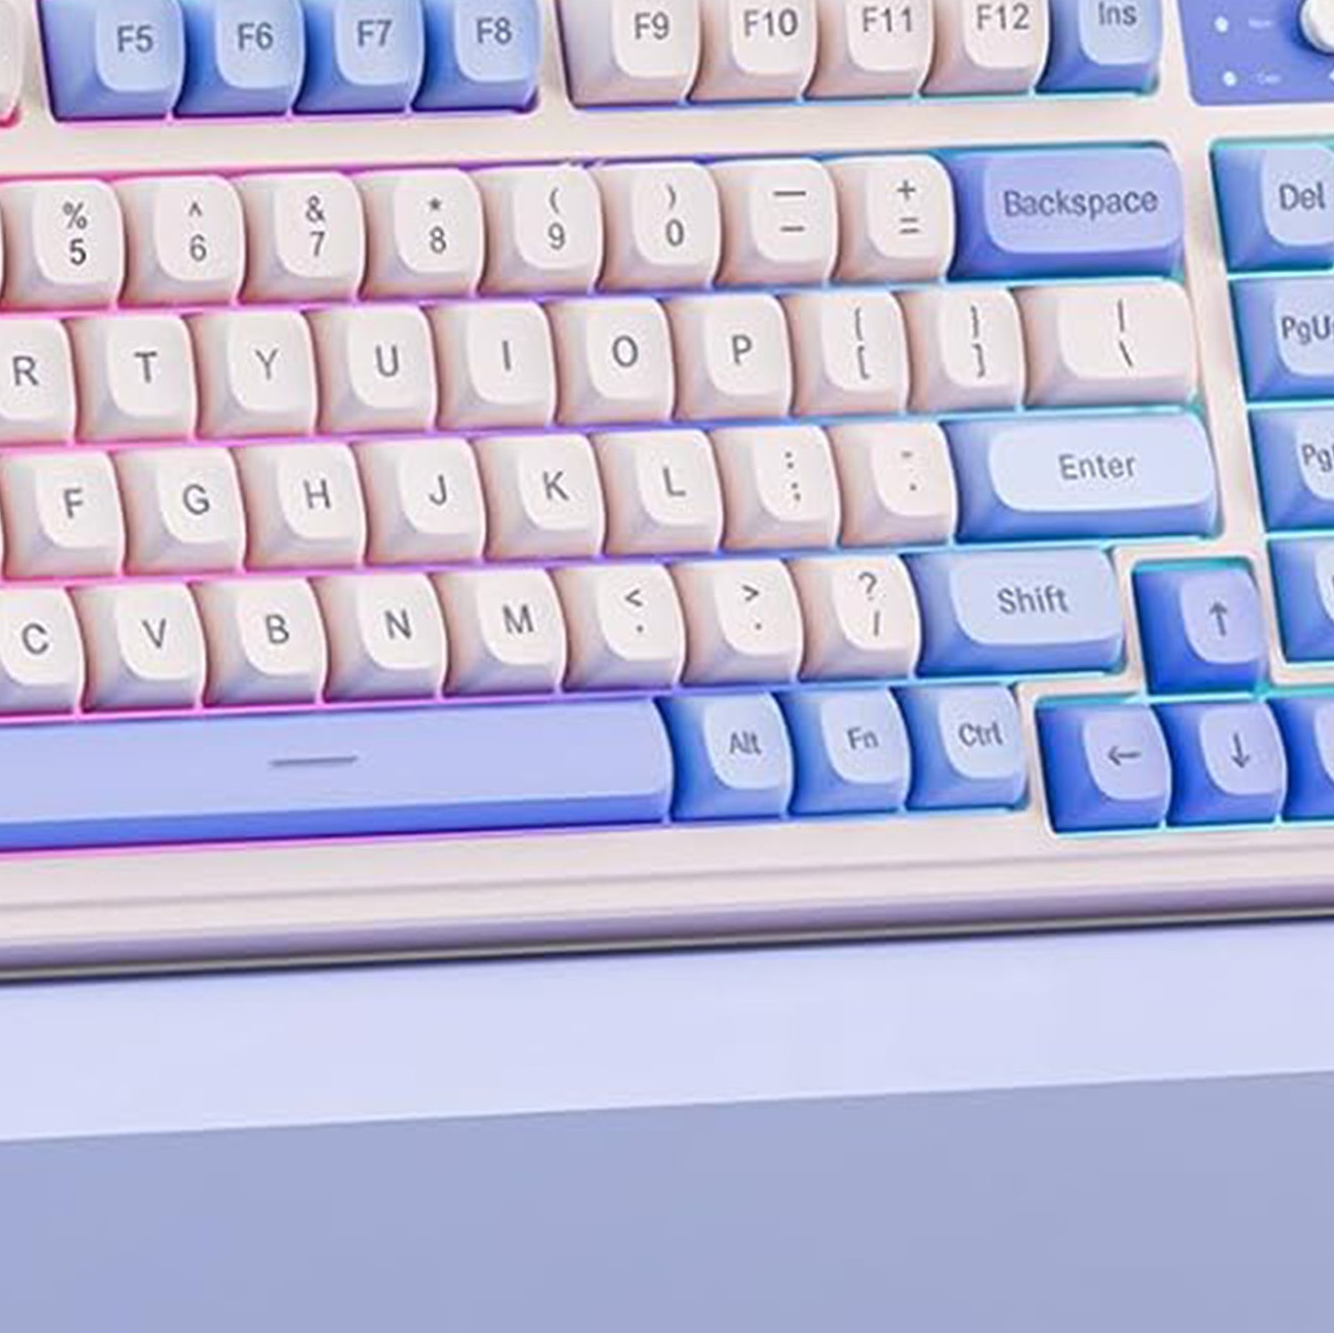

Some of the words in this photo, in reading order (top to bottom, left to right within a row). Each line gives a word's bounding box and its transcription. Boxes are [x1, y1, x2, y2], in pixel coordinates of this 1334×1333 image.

[635, 12, 669, 40] F9
[744, 9, 798, 36] F10
[862, 7, 911, 32] F11
[977, 3, 1029, 30] F12
[1099, 1, 1136, 25] Ins
[117, 25, 153, 52] F5
[238, 22, 273, 50] F6
[357, 20, 391, 47] F7
[477, 17, 512, 45] F8
[897, 180, 916, 200] +
[1279, 182, 1325, 210] Del
[63, 202, 87, 229] %
[306, 196, 324, 222] &
[1004, 190, 1158, 220] Backspace
[311, 231, 325, 256] 7
[430, 226, 446, 253] 8
[548, 223, 565, 250] 9
[666, 219, 684, 246] 0
[70, 238, 86, 265] 5
[190, 234, 206, 261] 6
[255, 349, 277, 379] Y
[376, 346, 399, 377] U
[502, 341, 511, 371] I
[612, 336, 638, 367] O
[732, 335, 752, 365] P
[13, 356, 38, 386] R
[134, 351, 157, 382] T
[1059, 454, 1134, 480] Enter
[304, 480, 330, 509] H
[430, 475, 447, 505] J
[543, 471, 568, 500] K
[663, 467, 686, 496] L
[64, 488, 83, 518] F
[183, 484, 210, 515] G
[859, 572, 877, 594] ?
[997, 585, 1068, 614] Shift
[265, 615, 289, 644] B
[385, 610, 411, 638] N
[503, 605, 533, 633] M
[22, 623, 48, 654] C
[142, 619, 166, 648] V
[730, 732, 761, 754] Alt
[847, 727, 878, 749] Fn
[959, 722, 1002, 747] Ctrl
